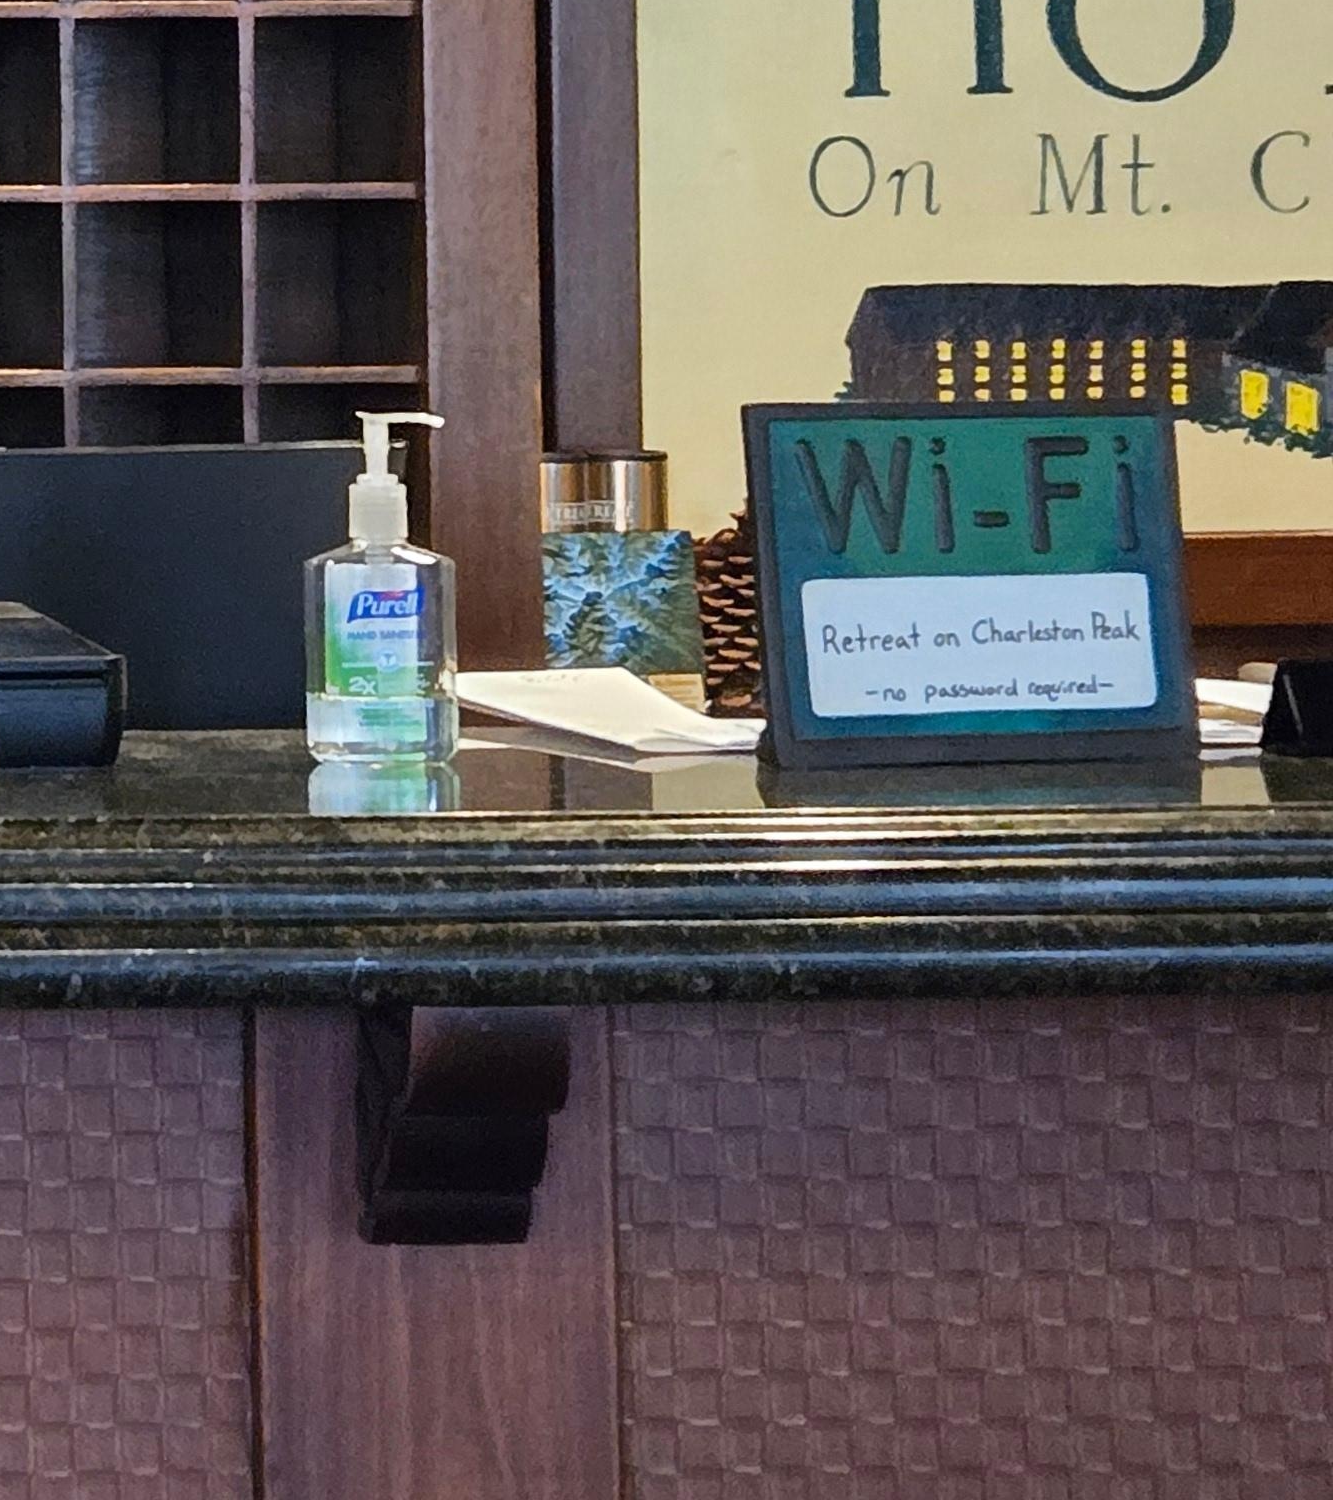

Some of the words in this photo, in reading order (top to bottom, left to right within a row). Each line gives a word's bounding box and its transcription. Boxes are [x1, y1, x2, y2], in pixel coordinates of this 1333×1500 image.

[809, 135, 941, 218] On
[1030, 133, 1171, 216] Mt.
[795, 434, 1141, 555] Wi-Fi
[357, 592, 419, 616] Purell
[822, 621, 921, 654] Retreat
[933, 632, 960, 647] on
[971, 617, 1085, 645] Charleston
[1091, 610, 1141, 641] Peak
[925, 679, 1018, 702] password
